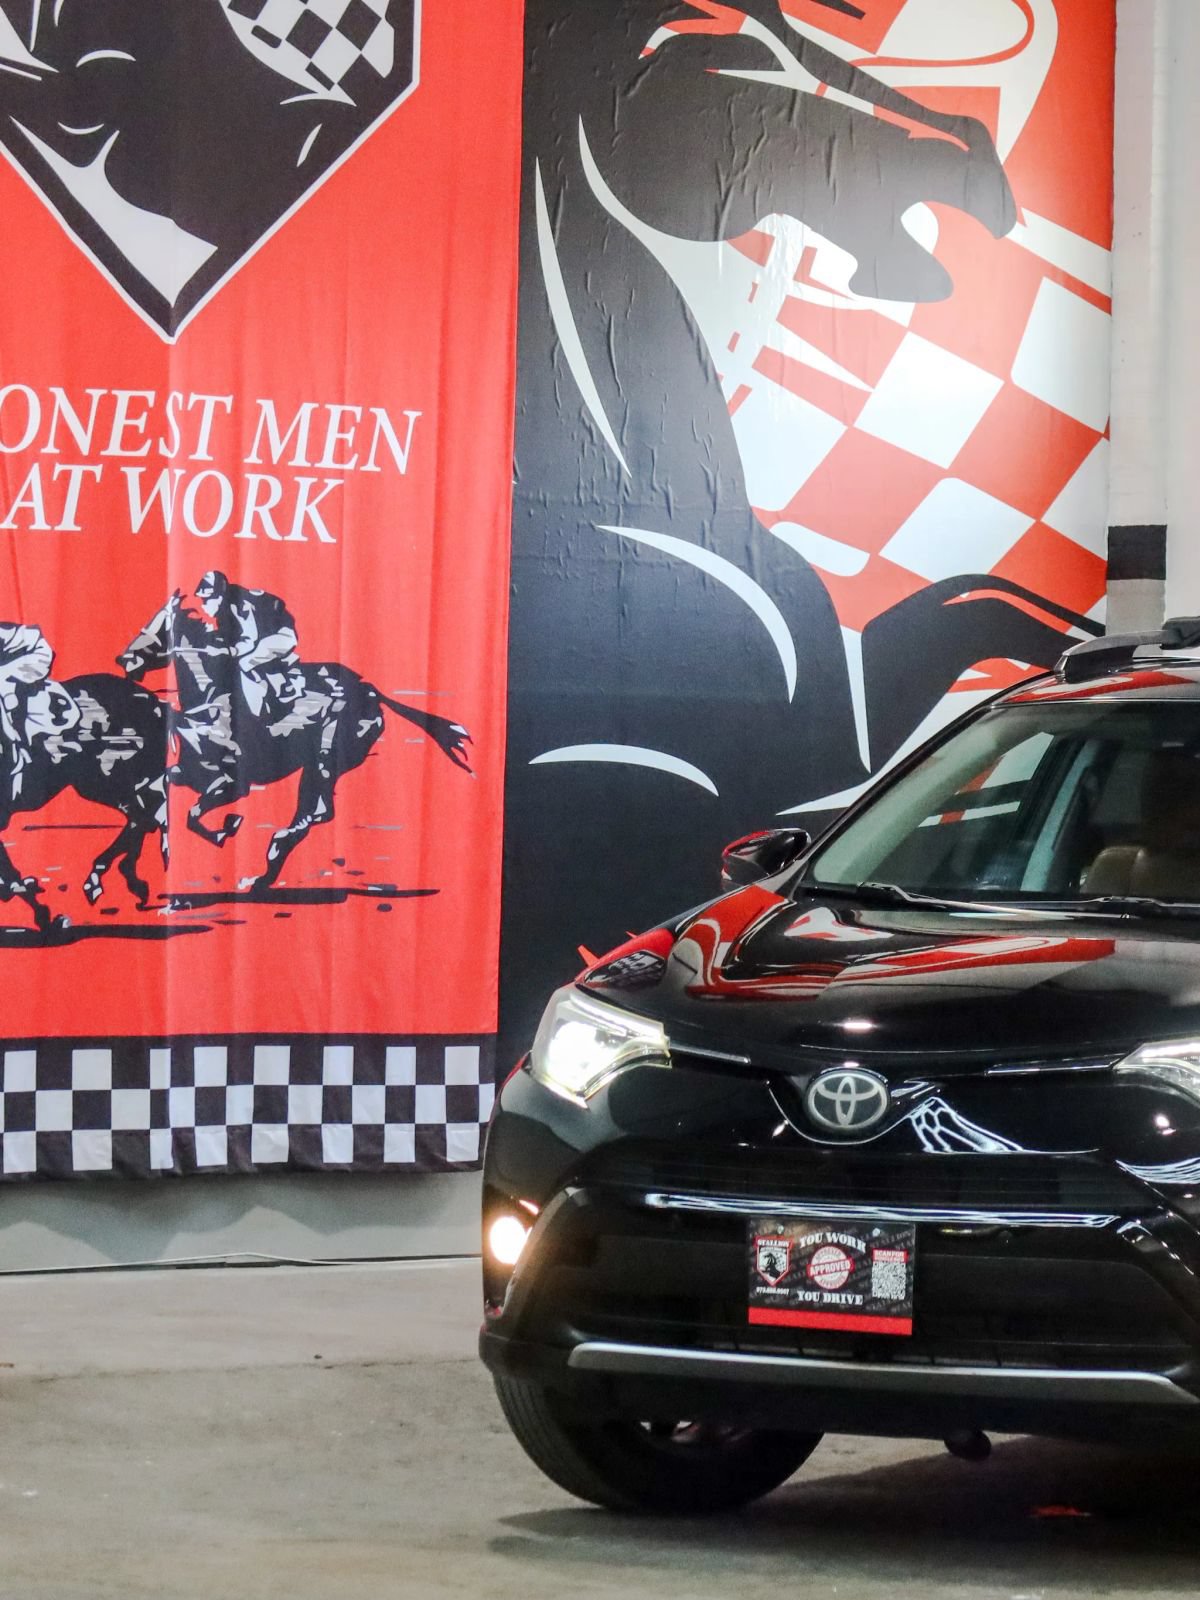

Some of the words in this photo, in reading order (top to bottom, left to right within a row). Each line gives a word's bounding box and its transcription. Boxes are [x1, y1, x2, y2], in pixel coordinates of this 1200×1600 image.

[244, 399, 422, 475] MEN
[2, 463, 102, 531] AT
[121, 466, 344, 543] WORK
[800, 1232, 823, 1249] YOU
[825, 1232, 866, 1253] WORK
[810, 1259, 850, 1277] APPROVED
[797, 1290, 821, 1302] YOU
[823, 1292, 863, 1306] DRIVE
